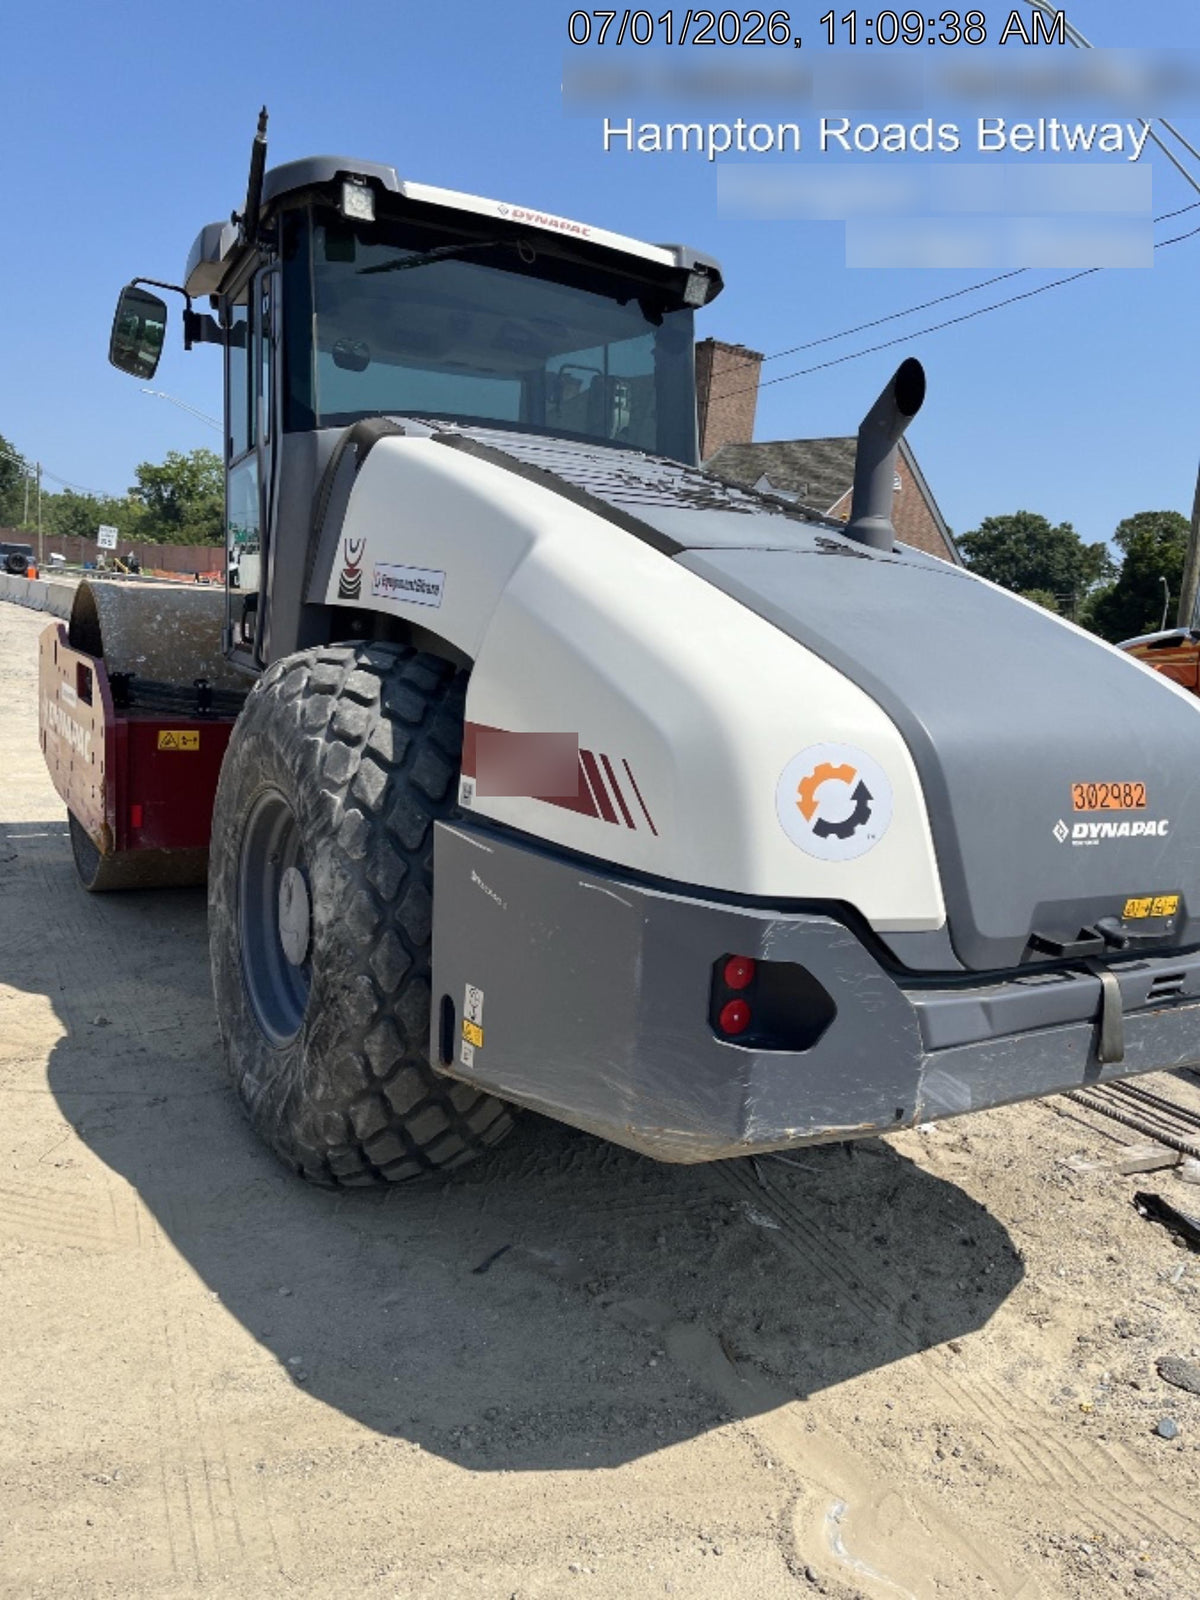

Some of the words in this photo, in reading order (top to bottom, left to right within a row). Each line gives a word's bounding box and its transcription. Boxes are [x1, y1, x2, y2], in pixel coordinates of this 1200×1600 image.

[512, 209, 591, 237] DYNAPAC
[1073, 783, 1146, 810] 302982
[1071, 819, 1169, 839] DYNAPAC
